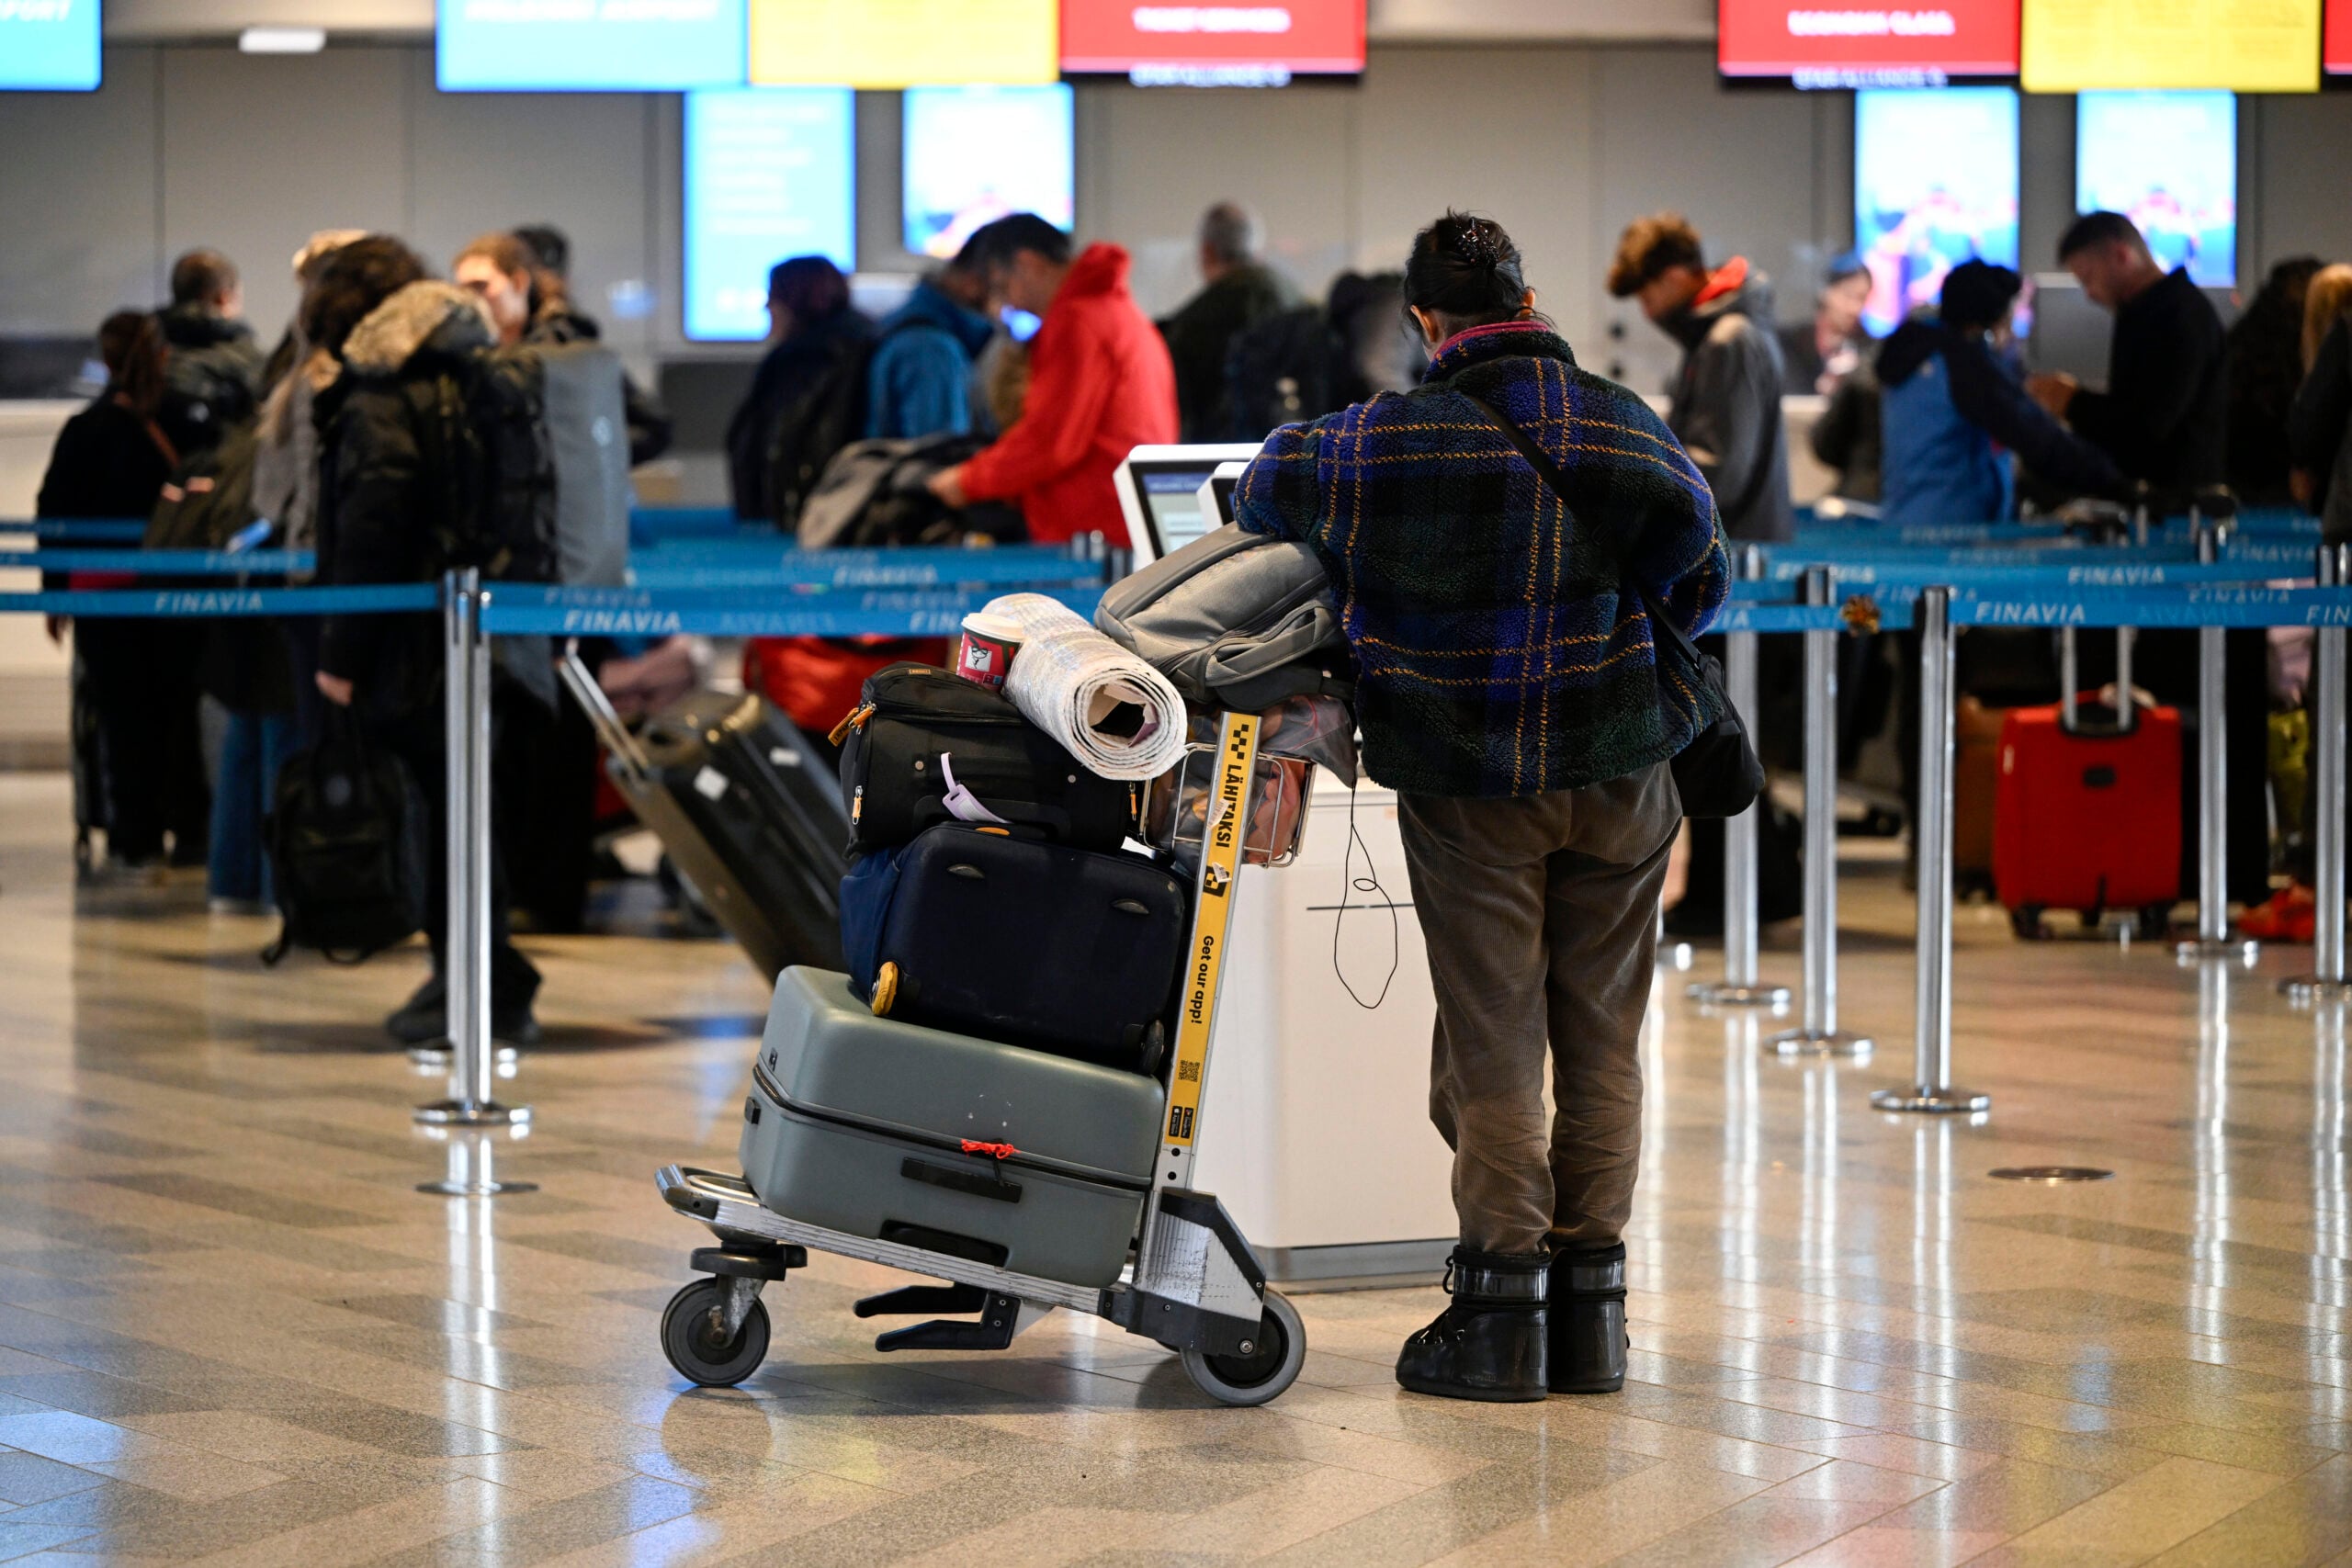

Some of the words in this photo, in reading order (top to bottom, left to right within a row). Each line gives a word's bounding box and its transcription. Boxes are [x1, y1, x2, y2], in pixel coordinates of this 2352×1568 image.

[2068, 566, 2165, 586] FINAVIA
[154, 592, 264, 614] FINAVIA
[1976, 602, 2086, 624] FINAVIA
[563, 610, 682, 632] FINAVIA
[1201, 935, 1214, 961] Get
[1197, 963, 1208, 988] our
[1189, 990, 1204, 1024] app!
